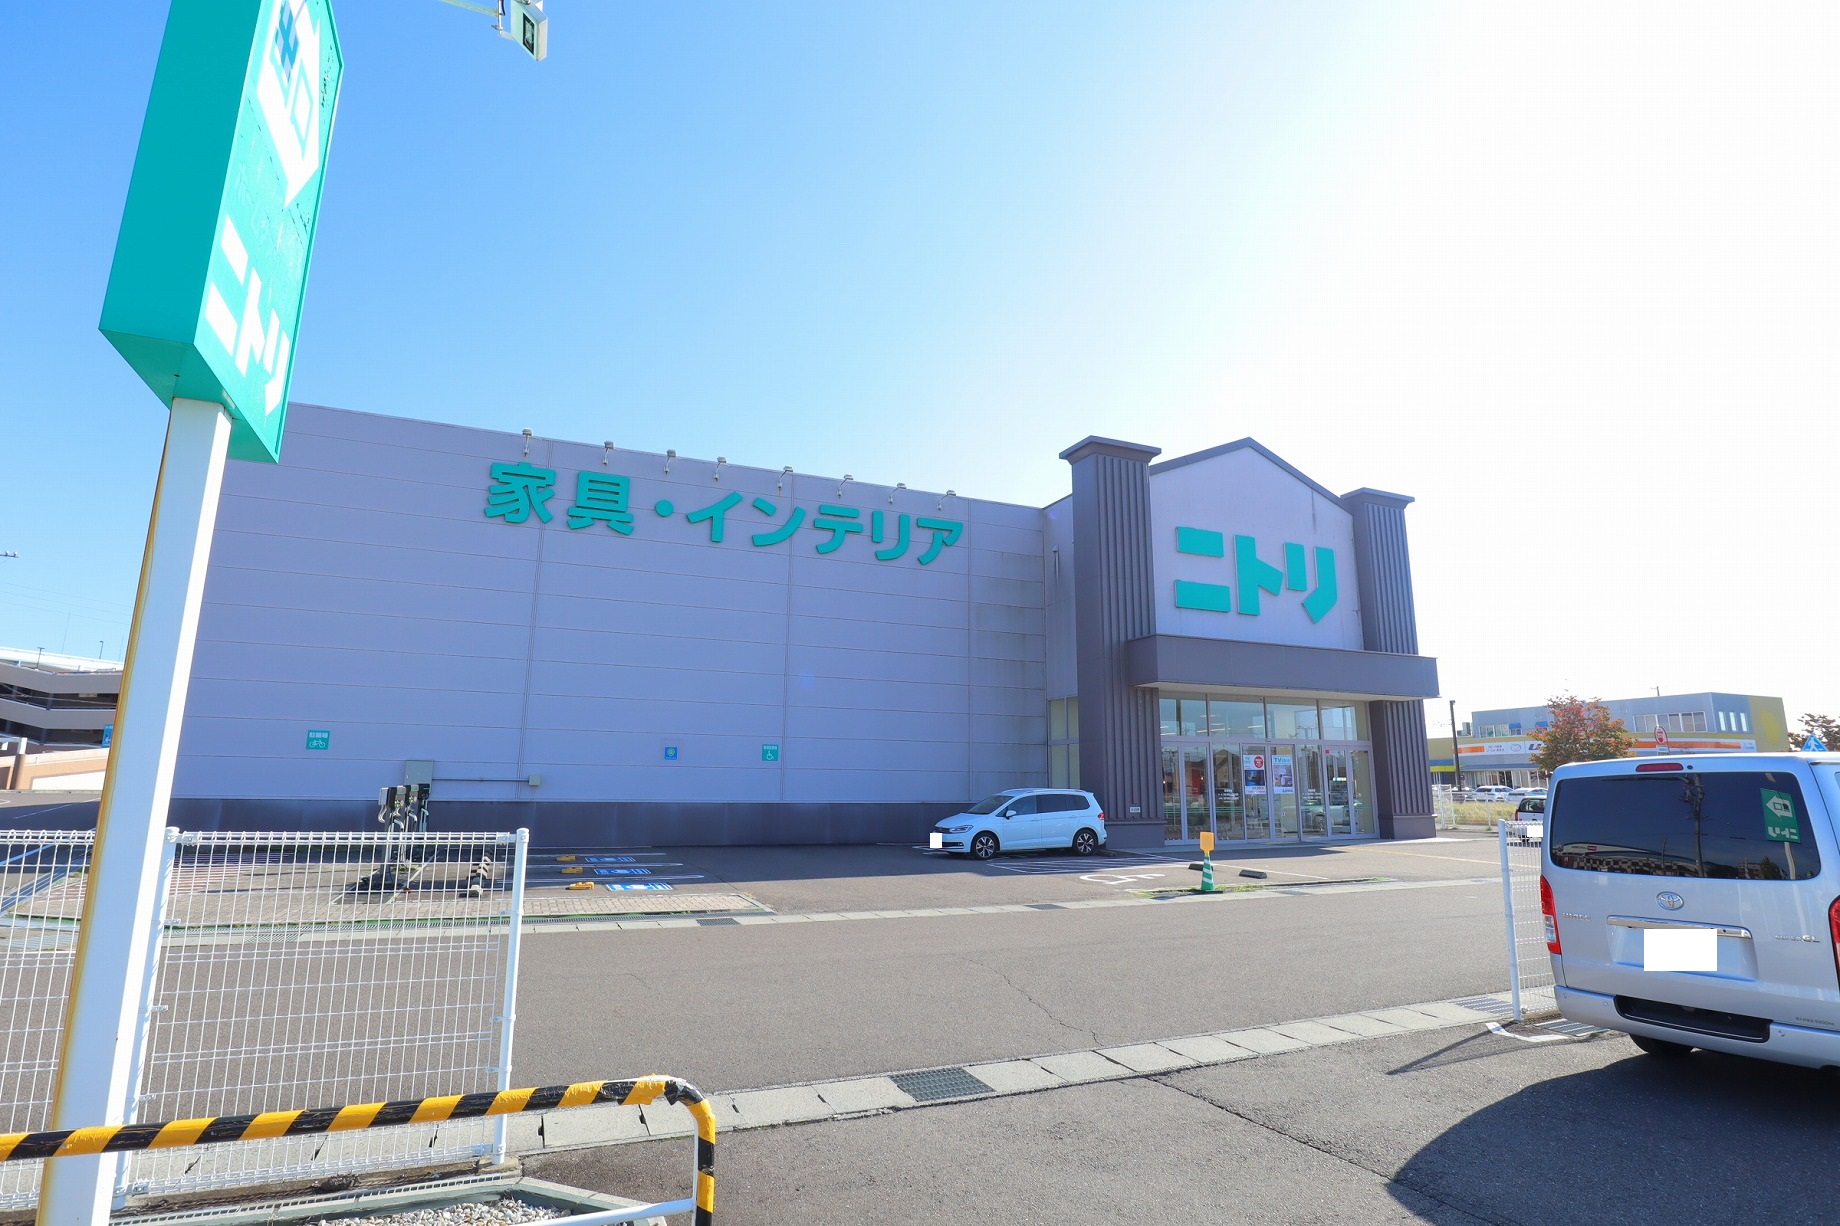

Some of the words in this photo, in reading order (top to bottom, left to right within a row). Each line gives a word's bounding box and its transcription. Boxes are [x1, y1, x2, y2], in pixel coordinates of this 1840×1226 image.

[205, 214, 289, 417] ニトリ
[484, 461, 964, 566] 家具・インテリア
[1175, 526, 1338, 624] ニトリ
